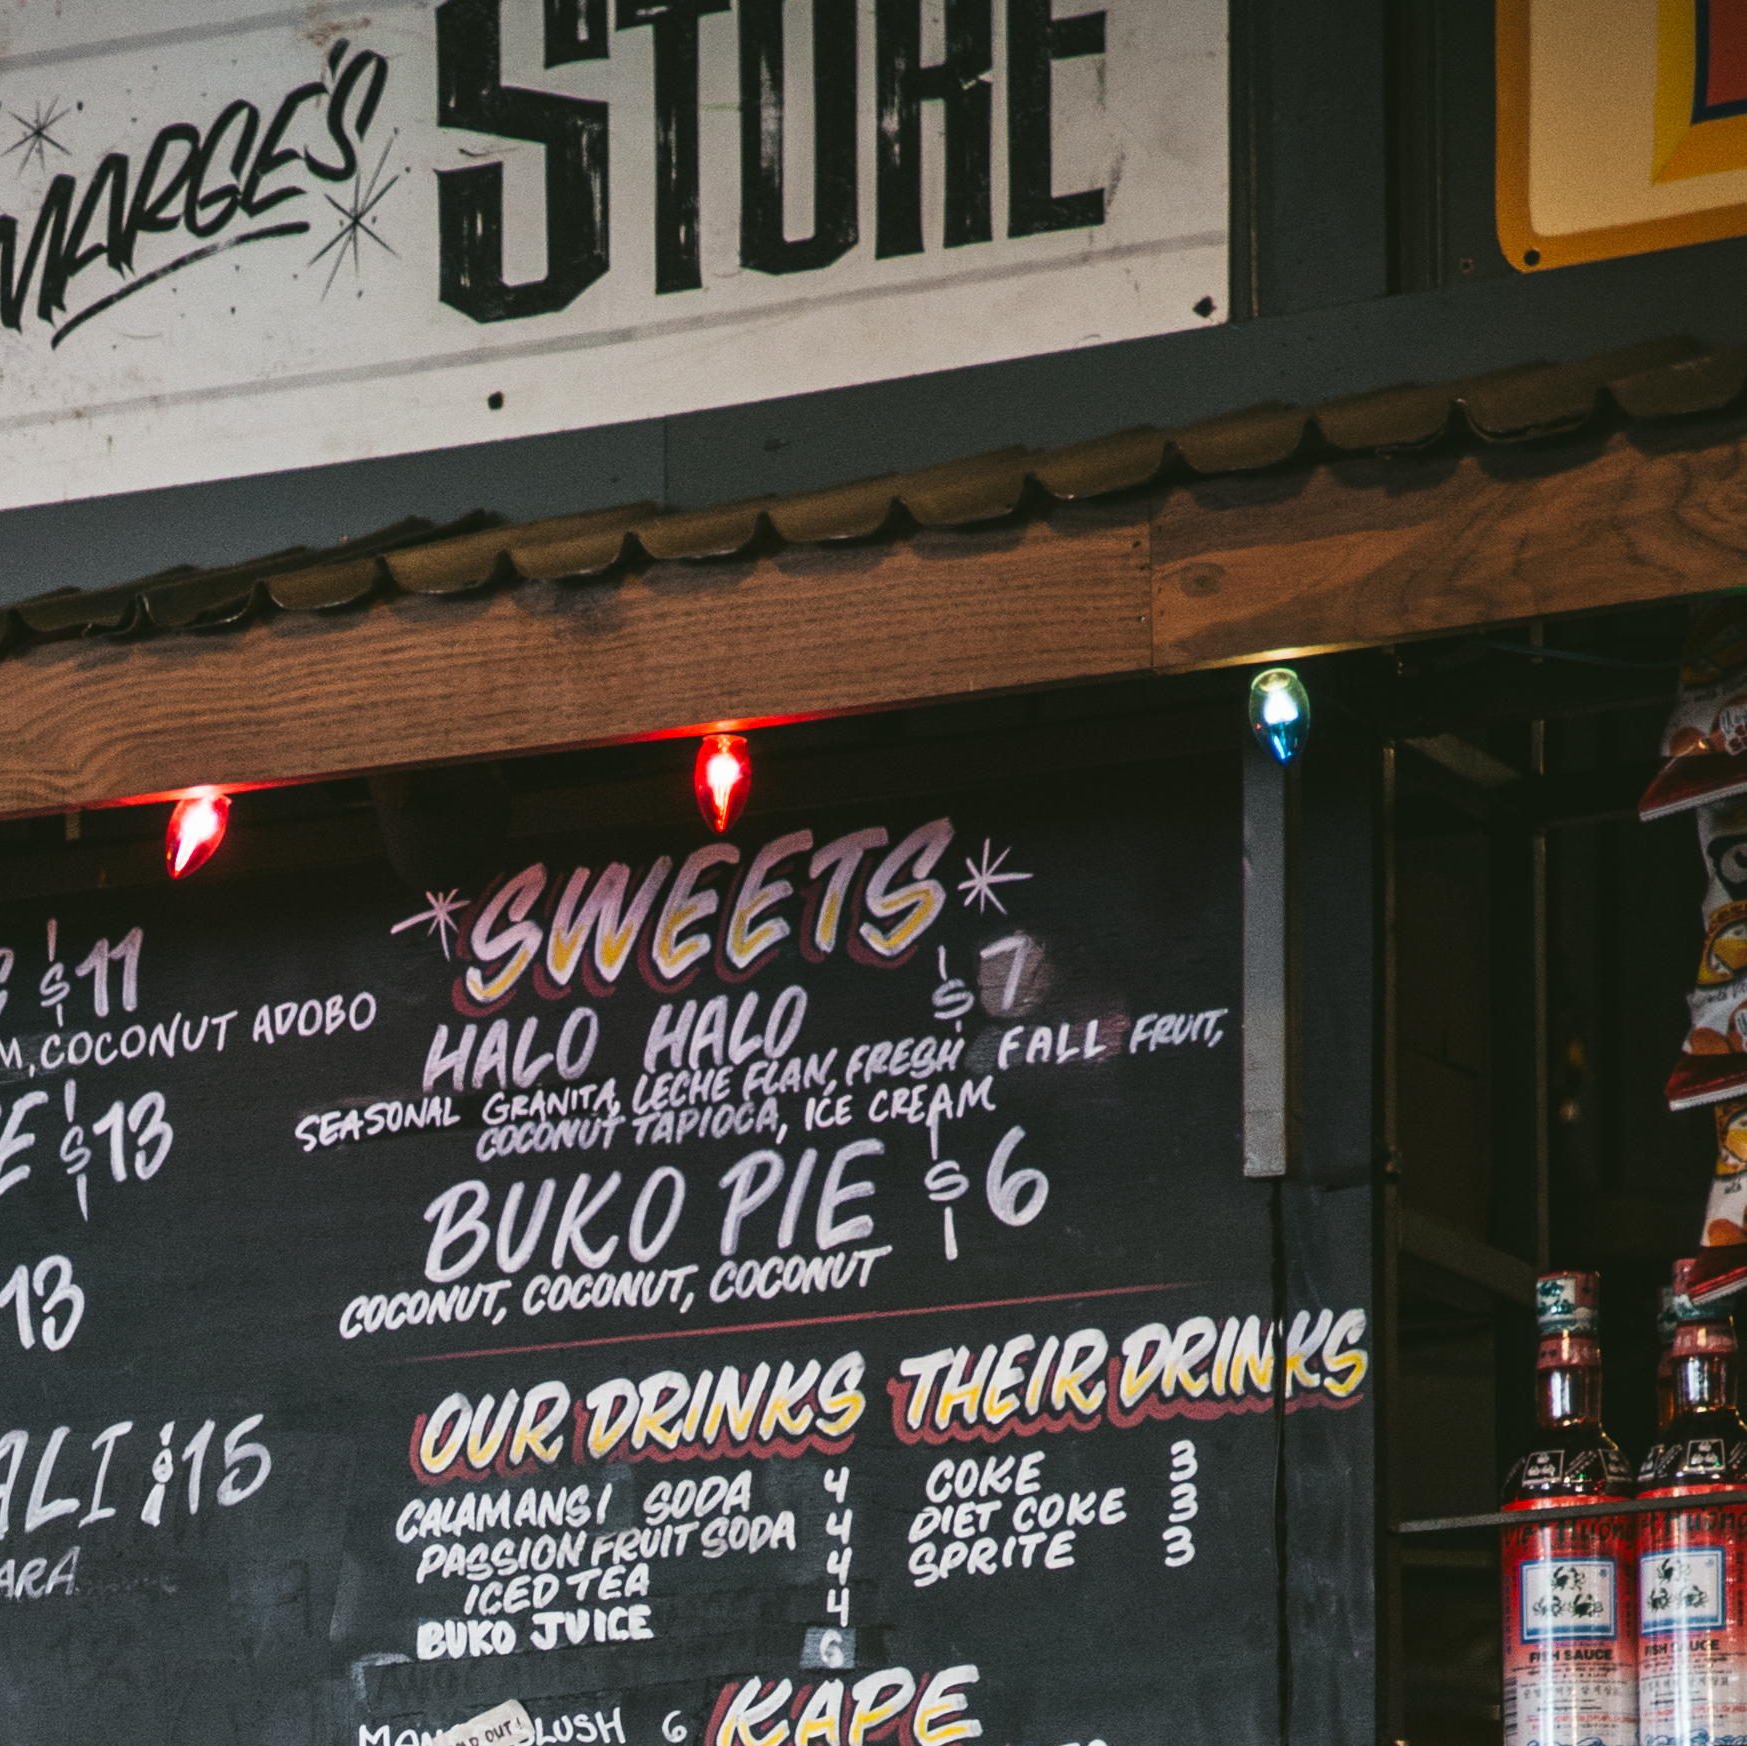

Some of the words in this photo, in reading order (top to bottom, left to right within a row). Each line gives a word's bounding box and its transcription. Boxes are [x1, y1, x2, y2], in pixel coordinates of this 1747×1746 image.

[434, 0, 1108, 323] STORE
[455, 818, 955, 1014] SWEETS
[40, 1011, 238, 1070] COCONUT
[252, 991, 376, 1044] ADOBO
[422, 1007, 598, 1092] HALO
[644, 985, 808, 1072] HALO
[295, 1094, 462, 1153] SEASONAL
[630, 1064, 733, 1114] LECHE
[997, 1018, 1108, 1070] FALL
[476, 1114, 622, 1163] COCONUT
[630, 1099, 789, 1146] TAPIOCA,
[868, 1075, 995, 1125] CREAM
[422, 1166, 686, 1283] BUKO
[718, 1137, 886, 1257] PIE
[338, 1278, 512, 1340] COCONUT,
[521, 1263, 697, 1316] COCONUT,
[708, 1245, 891, 1304] COCONUT
[887, 1331, 1109, 1443] THEIR
[1110, 1308, 1369, 1419] DRINKS
[414, 1378, 569, 1483] OUR
[575, 1350, 866, 1464] DRINKS
[395, 1483, 612, 1540] CALAMANSI
[642, 1469, 753, 1521] SODA
[823, 1467, 849, 1504] 4
[926, 1452, 1045, 1502] COKE
[1169, 1440, 1199, 1481] 3
[416, 1531, 586, 1584] PASSION
[590, 1521, 694, 1566] FRUIT
[700, 1510, 798, 1559] SODA
[824, 1509, 851, 1544] 4
[908, 1502, 1002, 1542] DIET
[1011, 1488, 1127, 1533] COKE
[1167, 1483, 1198, 1525] 3
[464, 1571, 553, 1617] ICED
[564, 1564, 652, 1606] TEA
[908, 1532, 1077, 1587] SPRITE
[1163, 1526, 1196, 1568] 3
[416, 1613, 516, 1661] BUKO
[529, 1604, 655, 1650] JUICE
[484, 1717, 523, 1744] OUT!
[662, 1710, 688, 1743] 6
